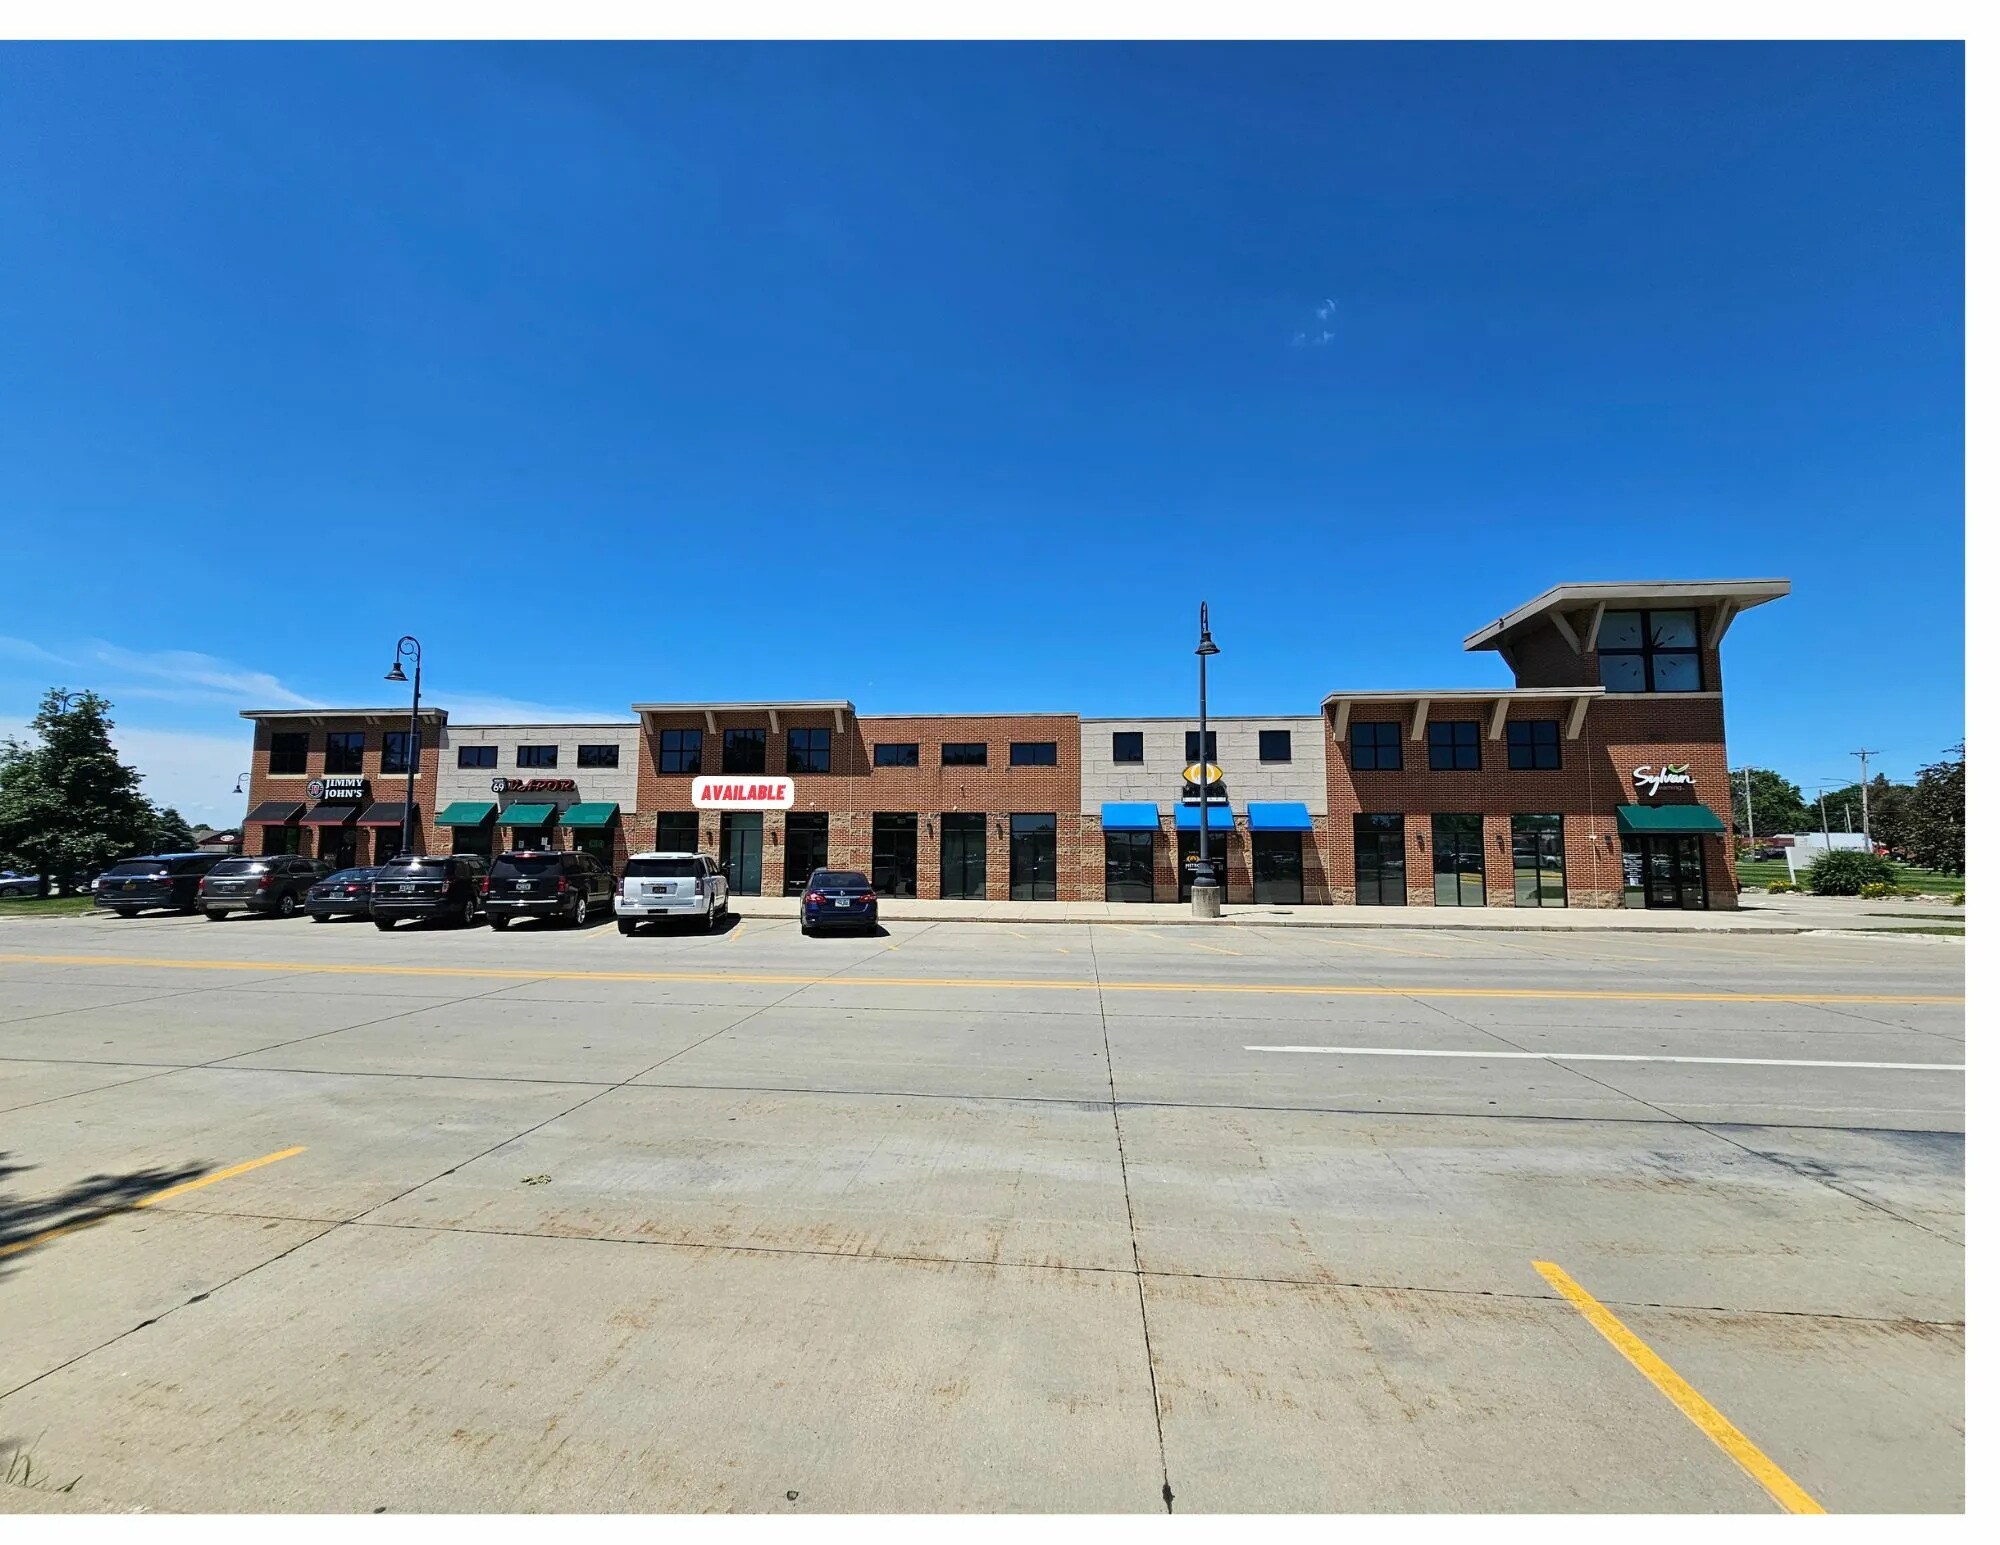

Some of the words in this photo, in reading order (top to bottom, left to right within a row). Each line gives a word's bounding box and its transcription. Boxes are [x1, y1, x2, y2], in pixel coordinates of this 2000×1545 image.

[325, 779, 363, 788] JIMMY
[1633, 766, 1696, 796] Sylvan
[492, 784, 504, 792] 69
[324, 790, 362, 799] JOHN'S
